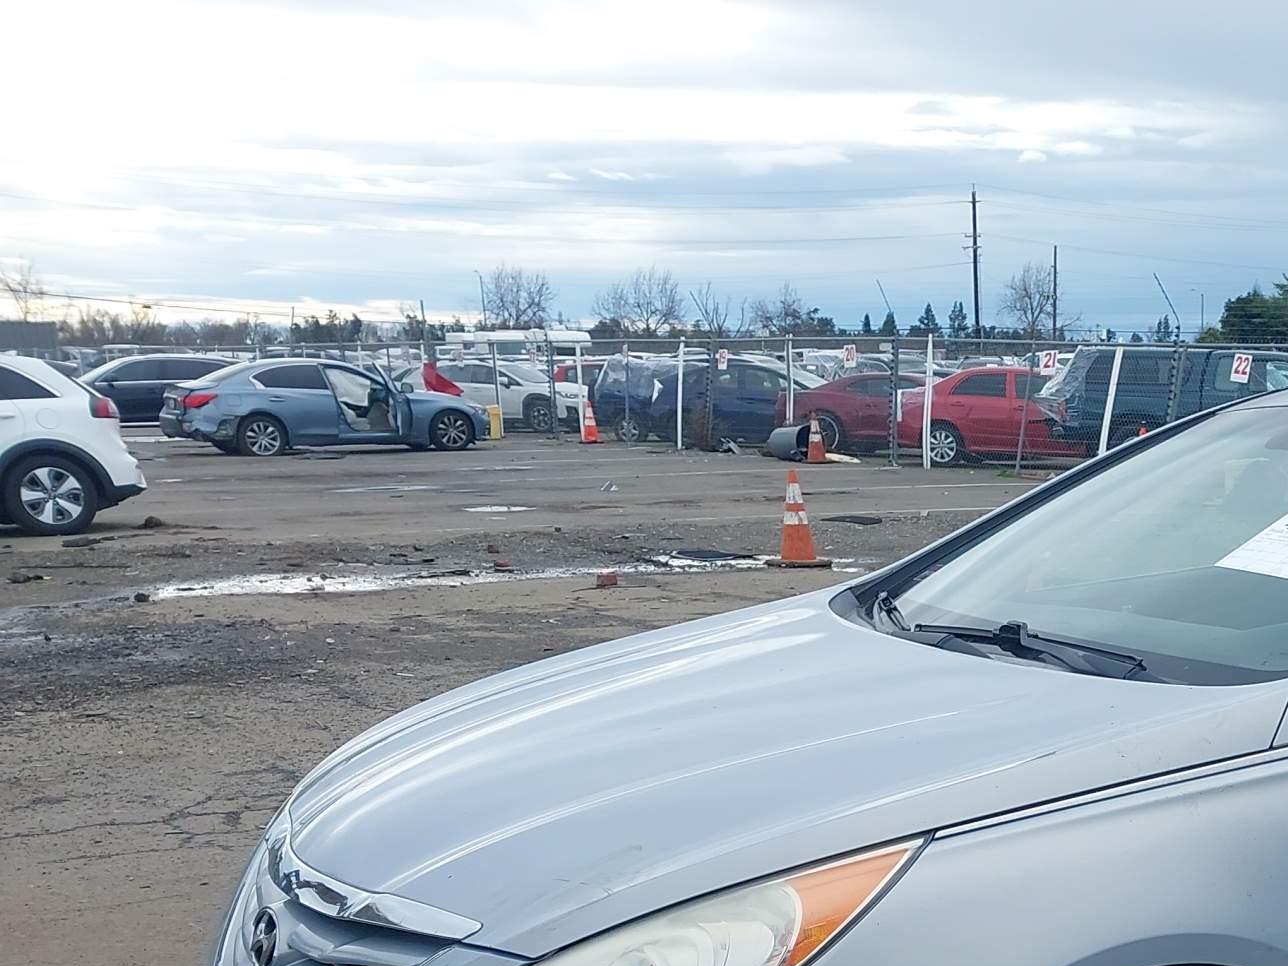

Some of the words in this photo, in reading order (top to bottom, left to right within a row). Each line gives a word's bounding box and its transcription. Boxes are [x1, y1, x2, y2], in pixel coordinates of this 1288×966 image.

[845, 346, 854, 361] 20
[1043, 352, 1056, 368] 21
[1233, 355, 1250, 375] 22
